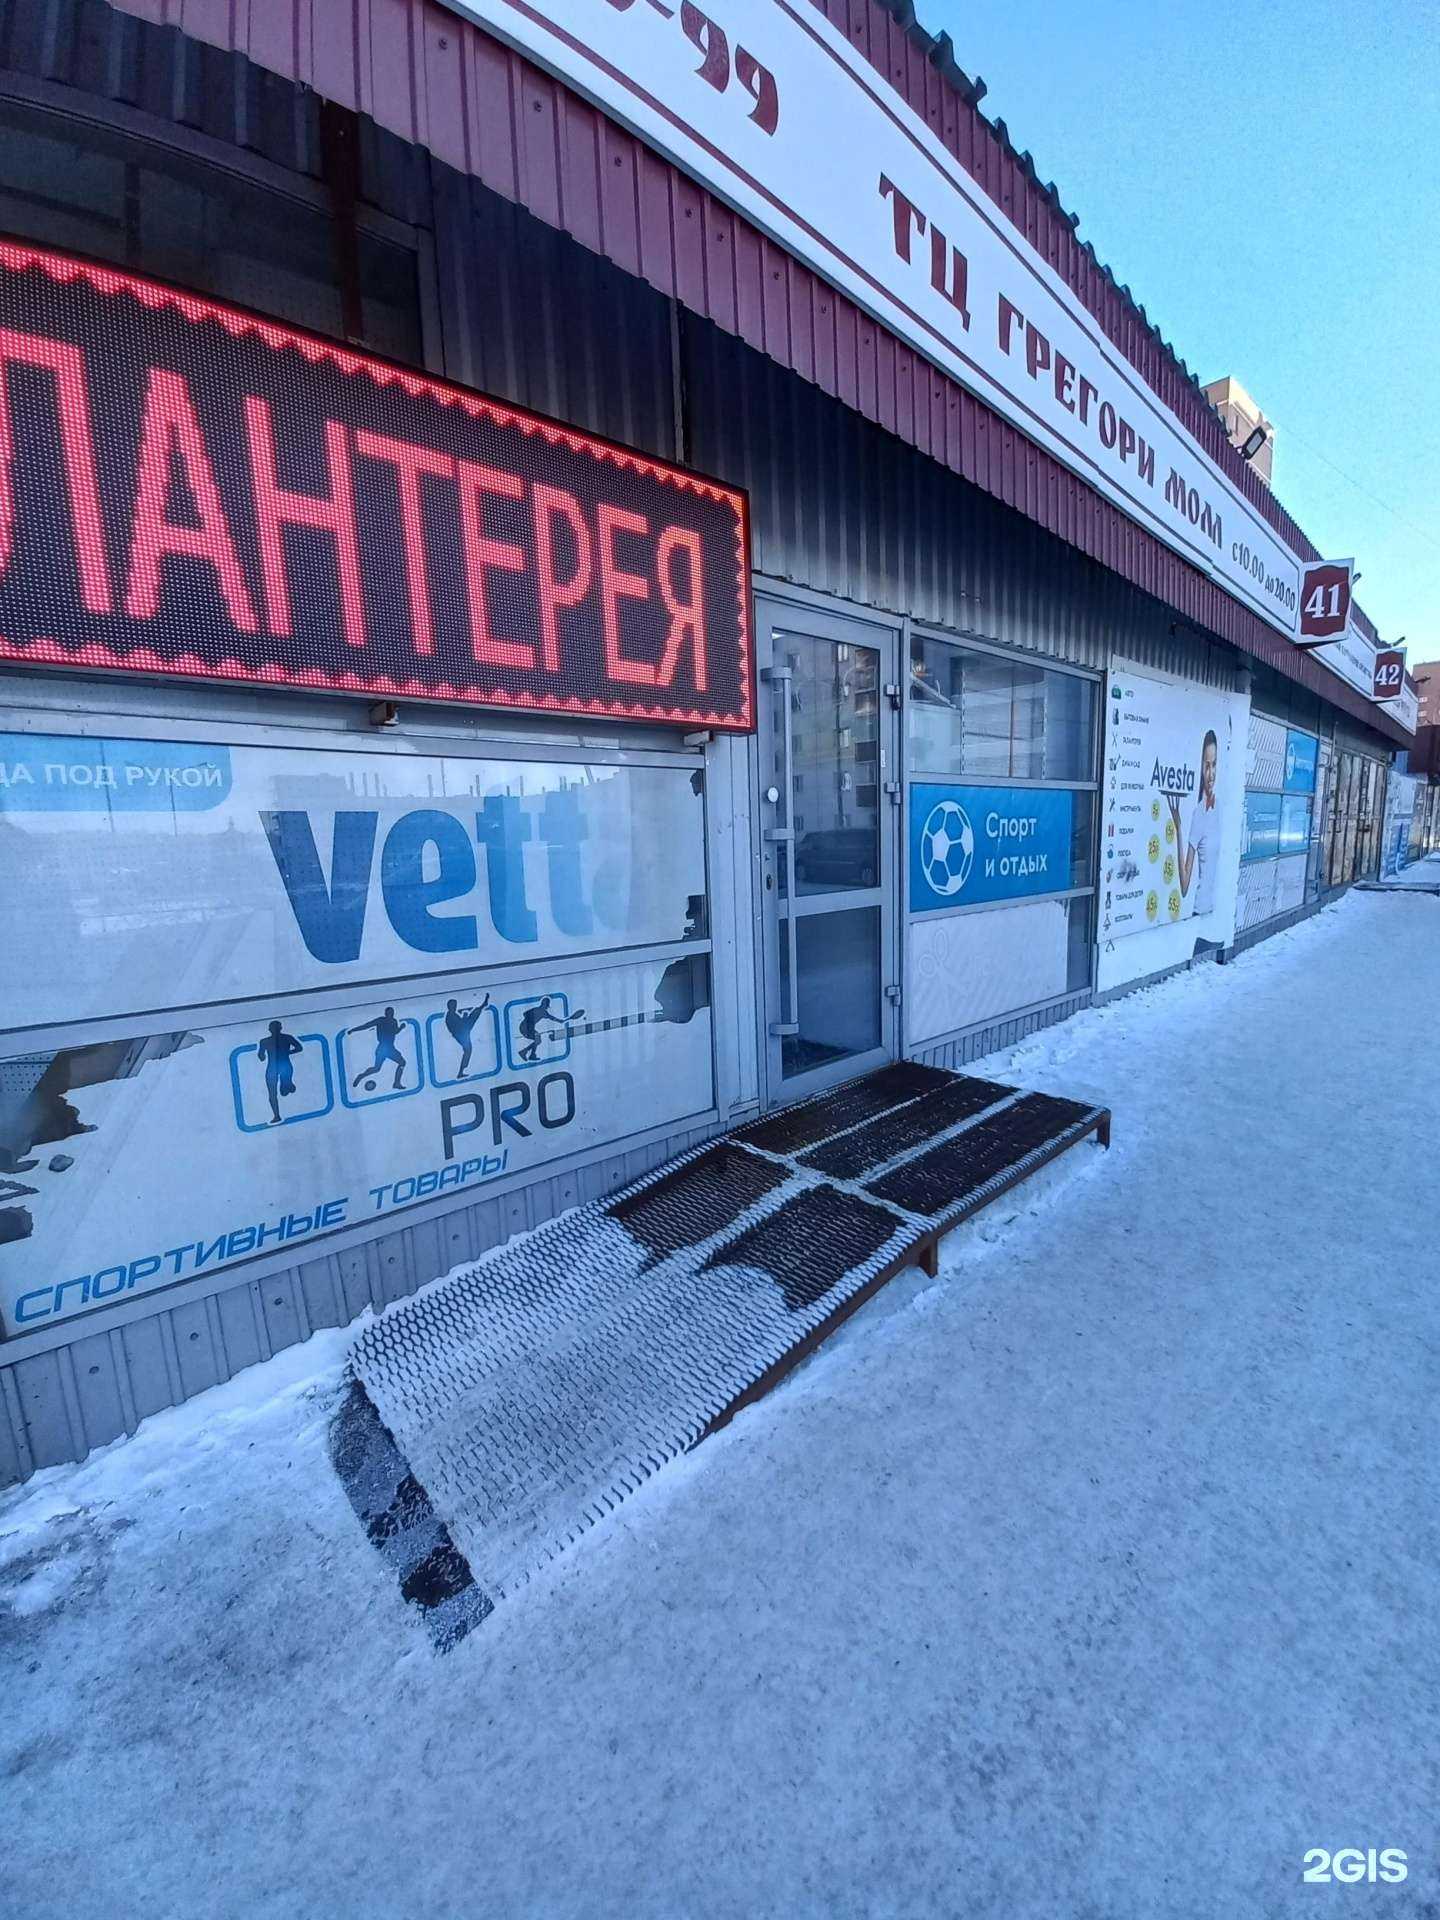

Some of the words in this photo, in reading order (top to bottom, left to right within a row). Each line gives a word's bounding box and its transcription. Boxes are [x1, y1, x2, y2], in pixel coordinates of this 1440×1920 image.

[604, 0, 779, 137] -99
[879, 172, 971, 332] ТЦ
[998, 292, 1155, 488] ГРЕГОРИ
[1164, 466, 1223, 549] МОЛЛ
[1304, 583, 1341, 619] 41
[1375, 663, 1400, 686] 42
[44, 764, 118, 789] ПОД
[125, 762, 224, 788] РУКОЙ
[1150, 756, 1195, 792] Avesta
[986, 812, 1037, 843] Спорт
[985, 858, 995, 878] и
[999, 854, 1048, 877] отдых
[440, 1071, 576, 1160] PRO
[15, 1198, 348, 1323] СПОРТИВНЫЕ
[369, 1150, 508, 1210] ТОВАРЫ
